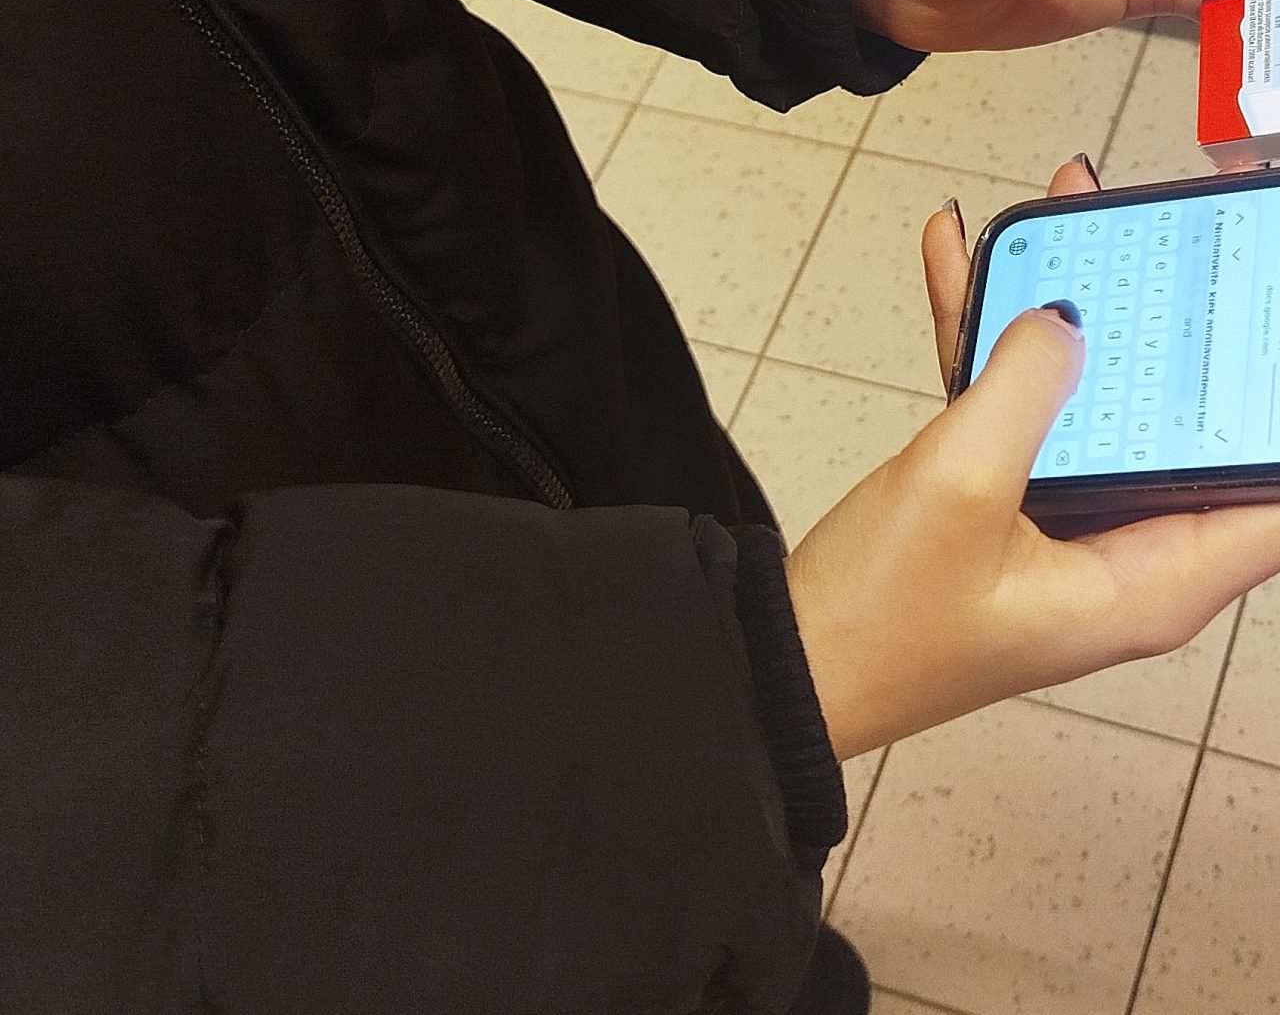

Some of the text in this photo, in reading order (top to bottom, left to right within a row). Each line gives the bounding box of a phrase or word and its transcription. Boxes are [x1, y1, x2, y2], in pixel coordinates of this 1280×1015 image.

[1158, 212, 1172, 221] q
[1052, 224, 1064, 242] 123
[1158, 234, 1169, 246] w
[1155, 262, 1168, 270] e
[1117, 278, 1130, 287] d
[1207, 291, 1217, 315] kiek
[1261, 284, 1274, 356] docs.google.com
[1182, 318, 1193, 338] and
[1107, 330, 1122, 340] g
[1144, 339, 1158, 348] y
[1107, 356, 1122, 366] h
[1144, 366, 1156, 376] u
[1062, 412, 1074, 427] m
[1100, 412, 1115, 421] k
[1138, 422, 1150, 432] o
[1132, 451, 1147, 461] p
